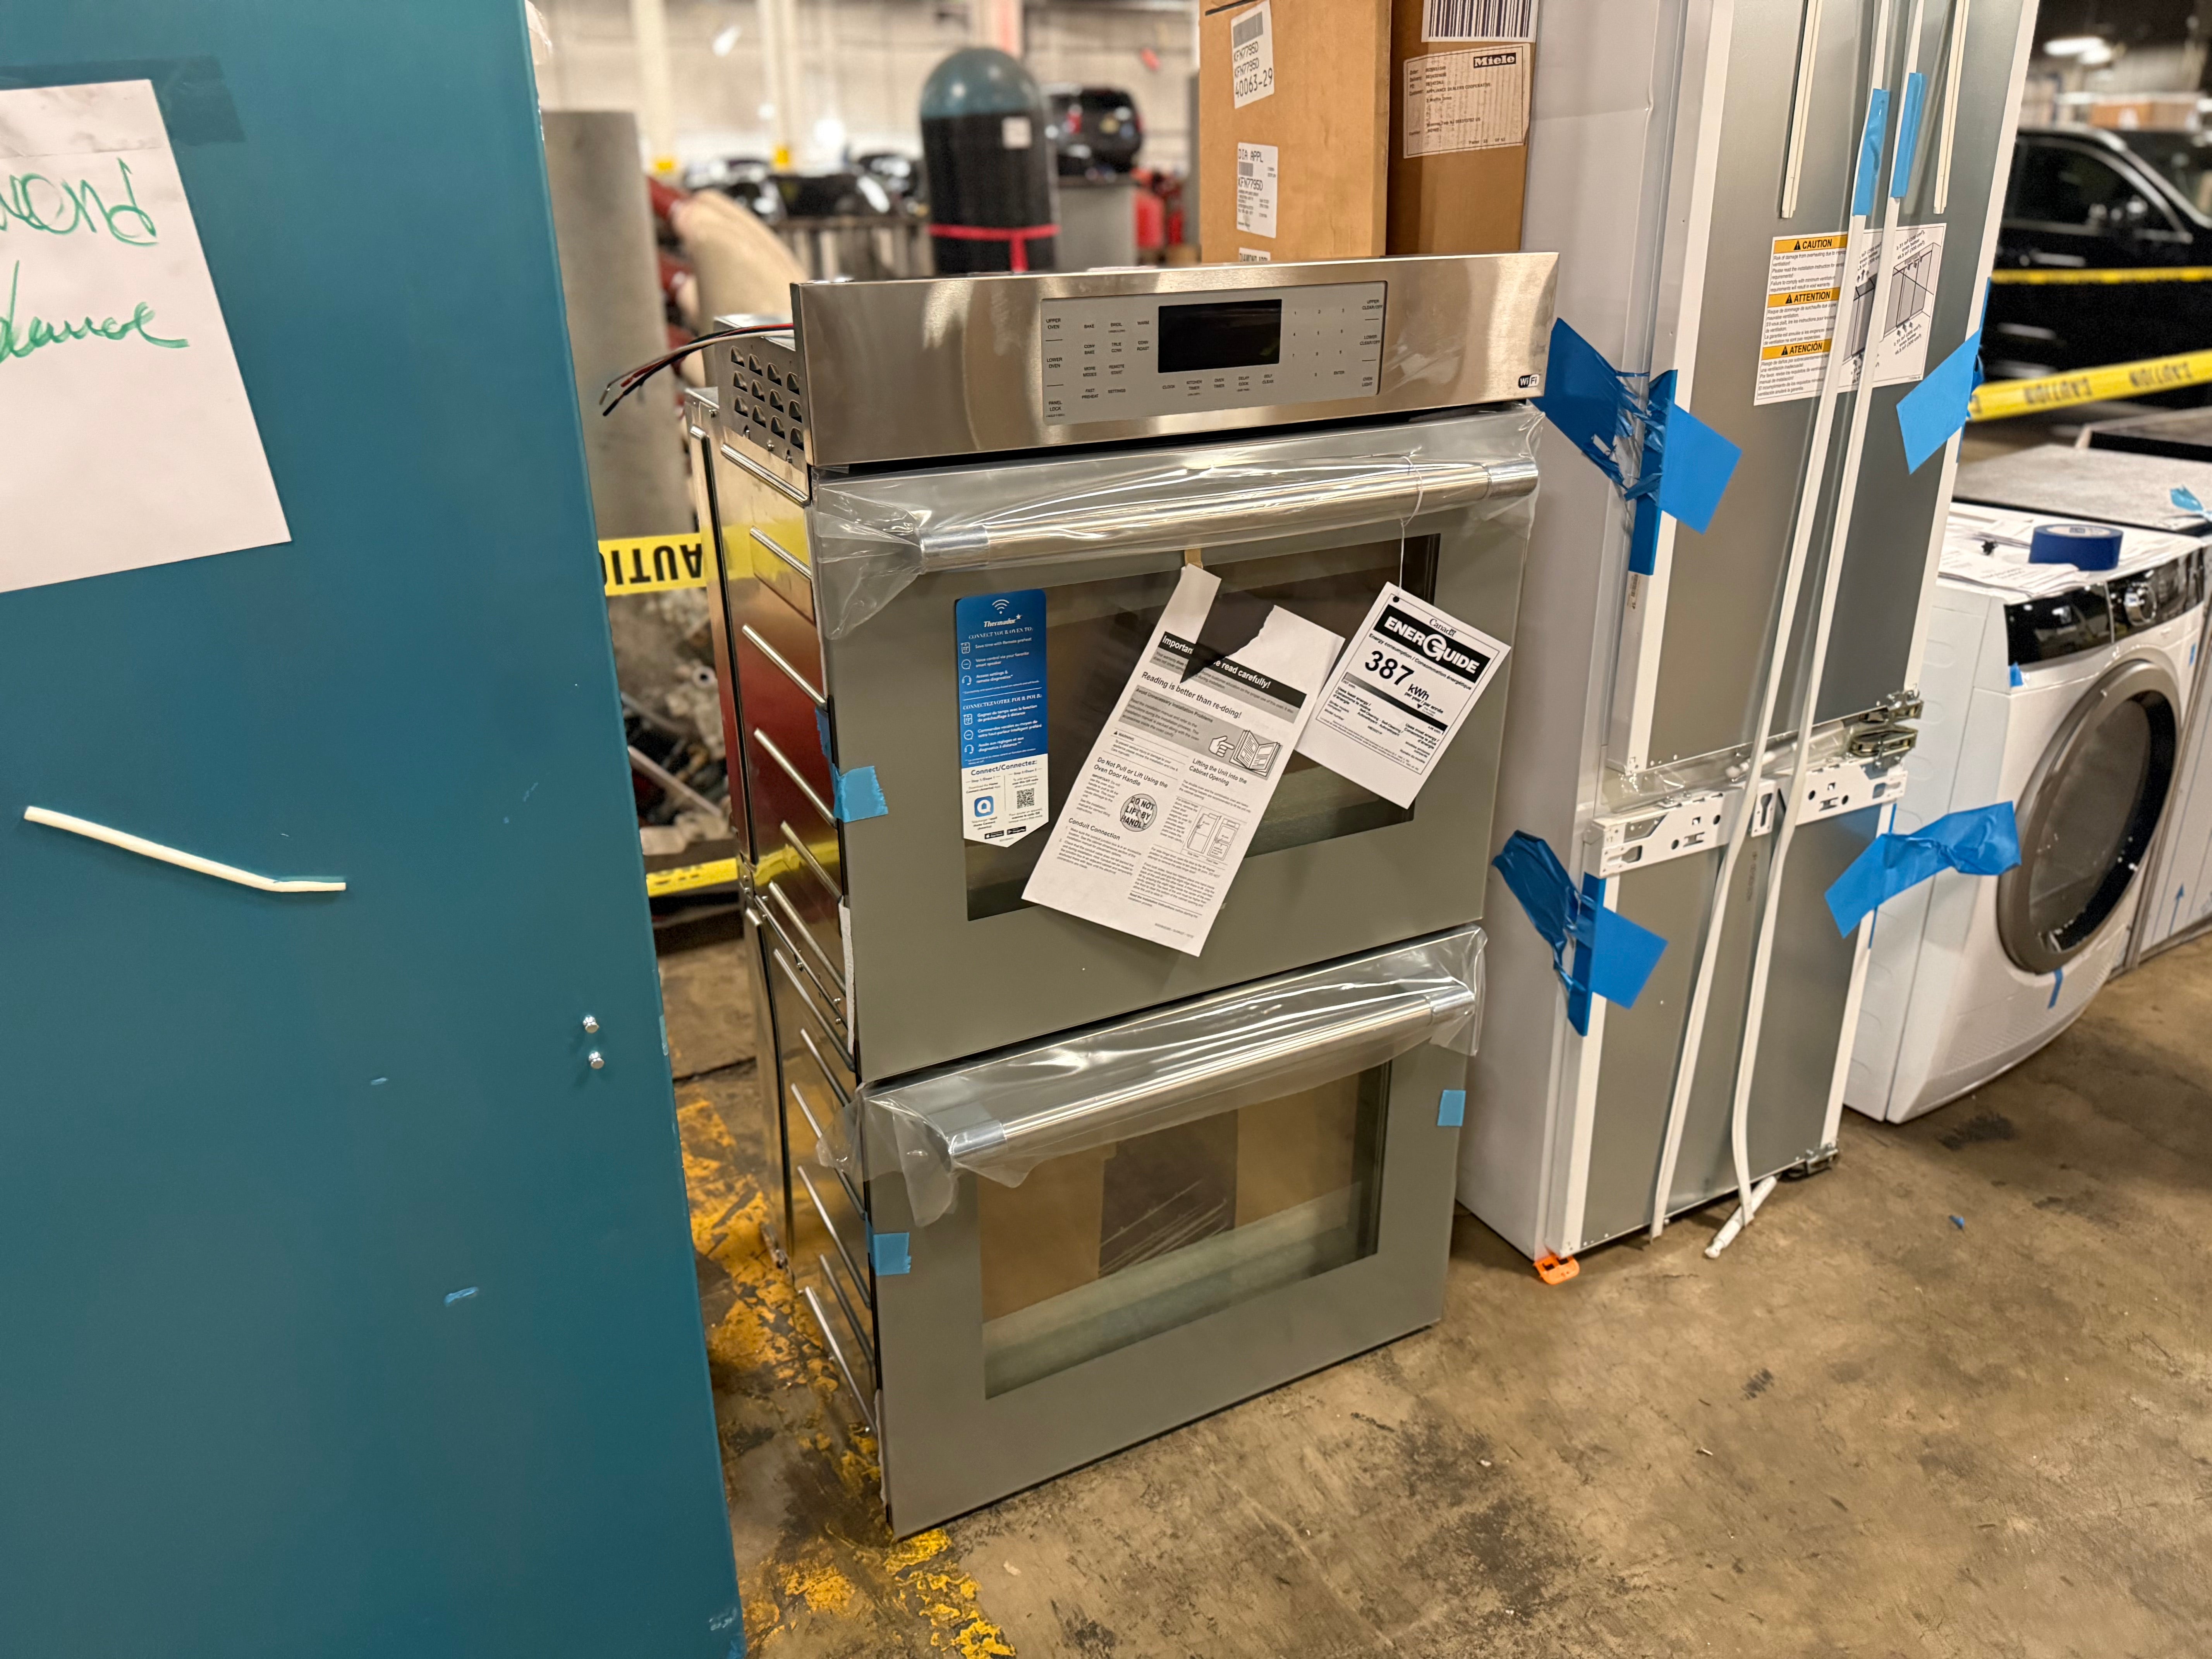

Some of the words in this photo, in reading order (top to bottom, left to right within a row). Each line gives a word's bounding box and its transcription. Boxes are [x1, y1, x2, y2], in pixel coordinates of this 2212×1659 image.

[1474, 55, 1515, 66] Miele
[1235, 68, 1273, 98] 40063-29
[1802, 239, 1832, 249] CAUTION
[1793, 291, 1830, 302] ATTENTION
[1789, 340, 1822, 354] ATENCIÓN
[600, 543, 702, 586] AUTI
[984, 618, 1016, 627] Thermador
[1429, 618, 1457, 637] Canada
[1369, 633, 1384, 644] Energy
[1384, 642, 1412, 659] consumption
[1414, 658, 1446, 677] Consommation
[1384, 617, 1479, 673] ENERGUIDE
[1221, 663, 1238, 674] read
[1238, 670, 1271, 688] carefully!
[1365, 651, 1414, 685] 387
[1141, 671, 1168, 689] Reading
[1168, 682, 1175, 690] is
[1175, 685, 1196, 698] better
[1196, 694, 1212, 706] than
[1212, 702, 1242, 719] re-doing!
[1407, 684, 1429, 700] kWh
[962, 701, 993, 710] CONNECTEZ
[1194, 711, 1213, 723] Problems
[1093, 764, 1108, 773] Oven
[1108, 769, 1122, 778] Door
[1122, 775, 1140, 786] Handle
[1115, 763, 1127, 772] Pull
[1143, 775, 1159, 785] Using
[1189, 765, 1209, 777] Cabinet
[1209, 773, 1229, 786] Opening
[1192, 758, 1209, 770] Lifting
[1217, 768, 1228, 776] Unit
[1228, 772, 1238, 780] into
[1124, 804, 1141, 817] LIFT
[1140, 811, 1151, 820] BY
[1129, 795, 1140, 805] DO
[1140, 800, 1156, 811] NOT
[1068, 817, 1090, 829] Conduit
[1090, 825, 1120, 840] Connection
[1120, 814, 1147, 830] HANDLE
